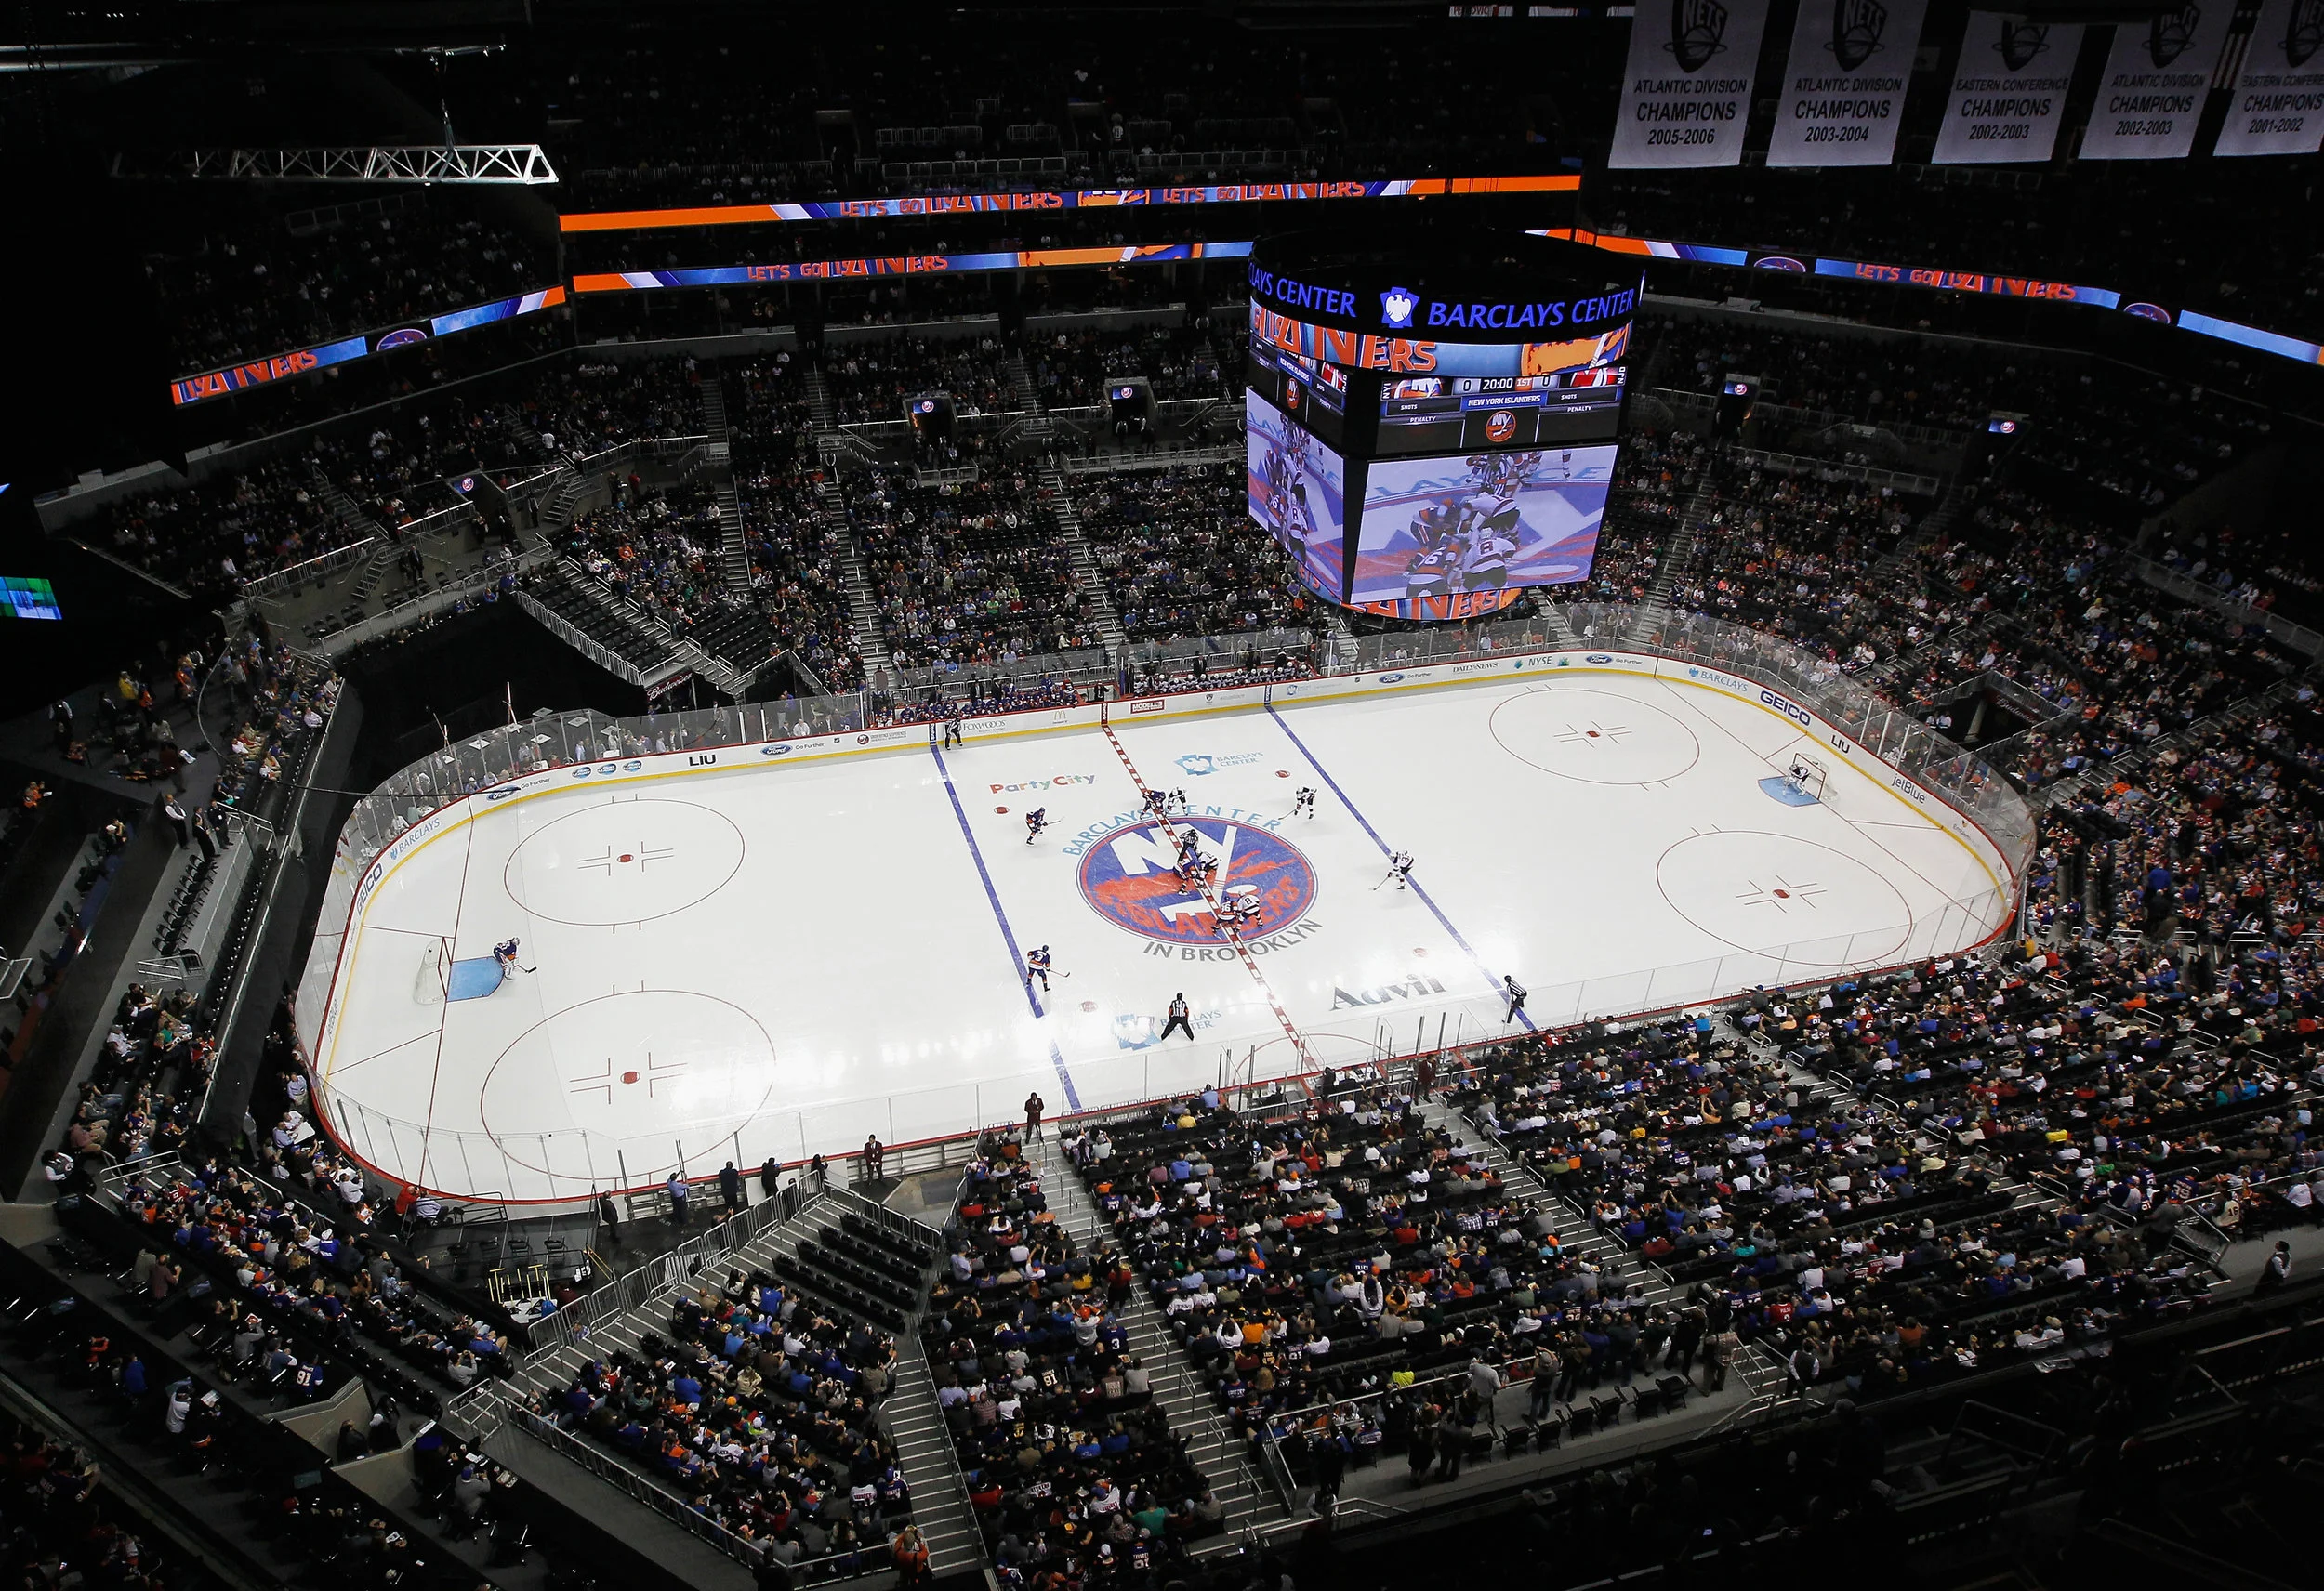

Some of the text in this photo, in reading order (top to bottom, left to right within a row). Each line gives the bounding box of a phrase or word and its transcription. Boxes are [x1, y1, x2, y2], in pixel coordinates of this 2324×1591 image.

[1633, 78, 1748, 94] ATLANTIC DIVISION
[1794, 76, 1903, 92] ATLANTIC DIVISION
[1956, 77, 2069, 92] EASTERN CONFERENCE
[2111, 73, 2206, 88] ATLANTIC DIVISION
[2241, 73, 2324, 88] EASTERN CONFERE
[1795, 99, 1891, 120] CHAMPIONS
[1961, 98, 2052, 119] CHAMPIONS
[2109, 94, 2194, 114] CHAMPIONS
[2243, 92, 2324, 112] CHAMPIONS
[1636, 101, 1736, 122] CHAMPIONS
[1804, 125, 1870, 143] 2003-2004
[1968, 124, 2030, 141] 2002-2003
[2115, 119, 2172, 137] 2002-2003
[2248, 117, 2304, 135] 2001-2002
[1647, 127, 1716, 146] 2005-2006
[1163, 186, 1206, 204] LET'S
[1216, 186, 1237, 201] GO
[839, 199, 887, 217] LET'S
[899, 198, 921, 214] GO
[747, 264, 791, 282] LET'S
[800, 262, 821, 277] GO
[1855, 262, 1901, 282] LET'S
[1910, 269, 1934, 284] GO
[1276, 278, 1358, 318] CENTER
[1427, 288, 1634, 329] BARCLAYS CENTER
[1382, 382, 1392, 400] NYI
[1462, 379, 1472, 392] 0
[1483, 377, 1514, 390] 20:00
[1516, 377, 1533, 388] 1ST
[1468, 394, 1541, 407] NEW YORK ISLANDERS
[1409, 415, 1437, 424] PENALTY
[1479, 540, 1494, 556] 8
[1527, 655, 1552, 666] NYSE
[1590, 655, 1609, 664] Ford
[1383, 675, 1402, 683] Ford
[1699, 670, 1748, 692] BARCLAYS
[1759, 690, 1812, 727] GEICO
[963, 719, 1006, 731] FOXWOODS
[765, 744, 787, 755] Ford
[804, 742, 825, 750] Further
[1830, 734, 1851, 754] LIU
[1216, 751, 1264, 765] BARCLAYS
[1219, 756, 1259, 769] CENTER
[521, 782, 533, 790] Go
[533, 776, 551, 787] Further
[989, 774, 1096, 795] Party City
[1891, 772, 1926, 805] jetBlue
[398, 817, 441, 853] BARCLAYS
[1062, 806, 1155, 857] BARCLAYS
[356, 861, 384, 915] GEICO
[1244, 897, 1253, 905] 8
[1142, 917, 1324, 963] IN BROOKLYN
[1110, 1337, 1121, 1351] 3
[296, 1370, 312, 1387] 91
